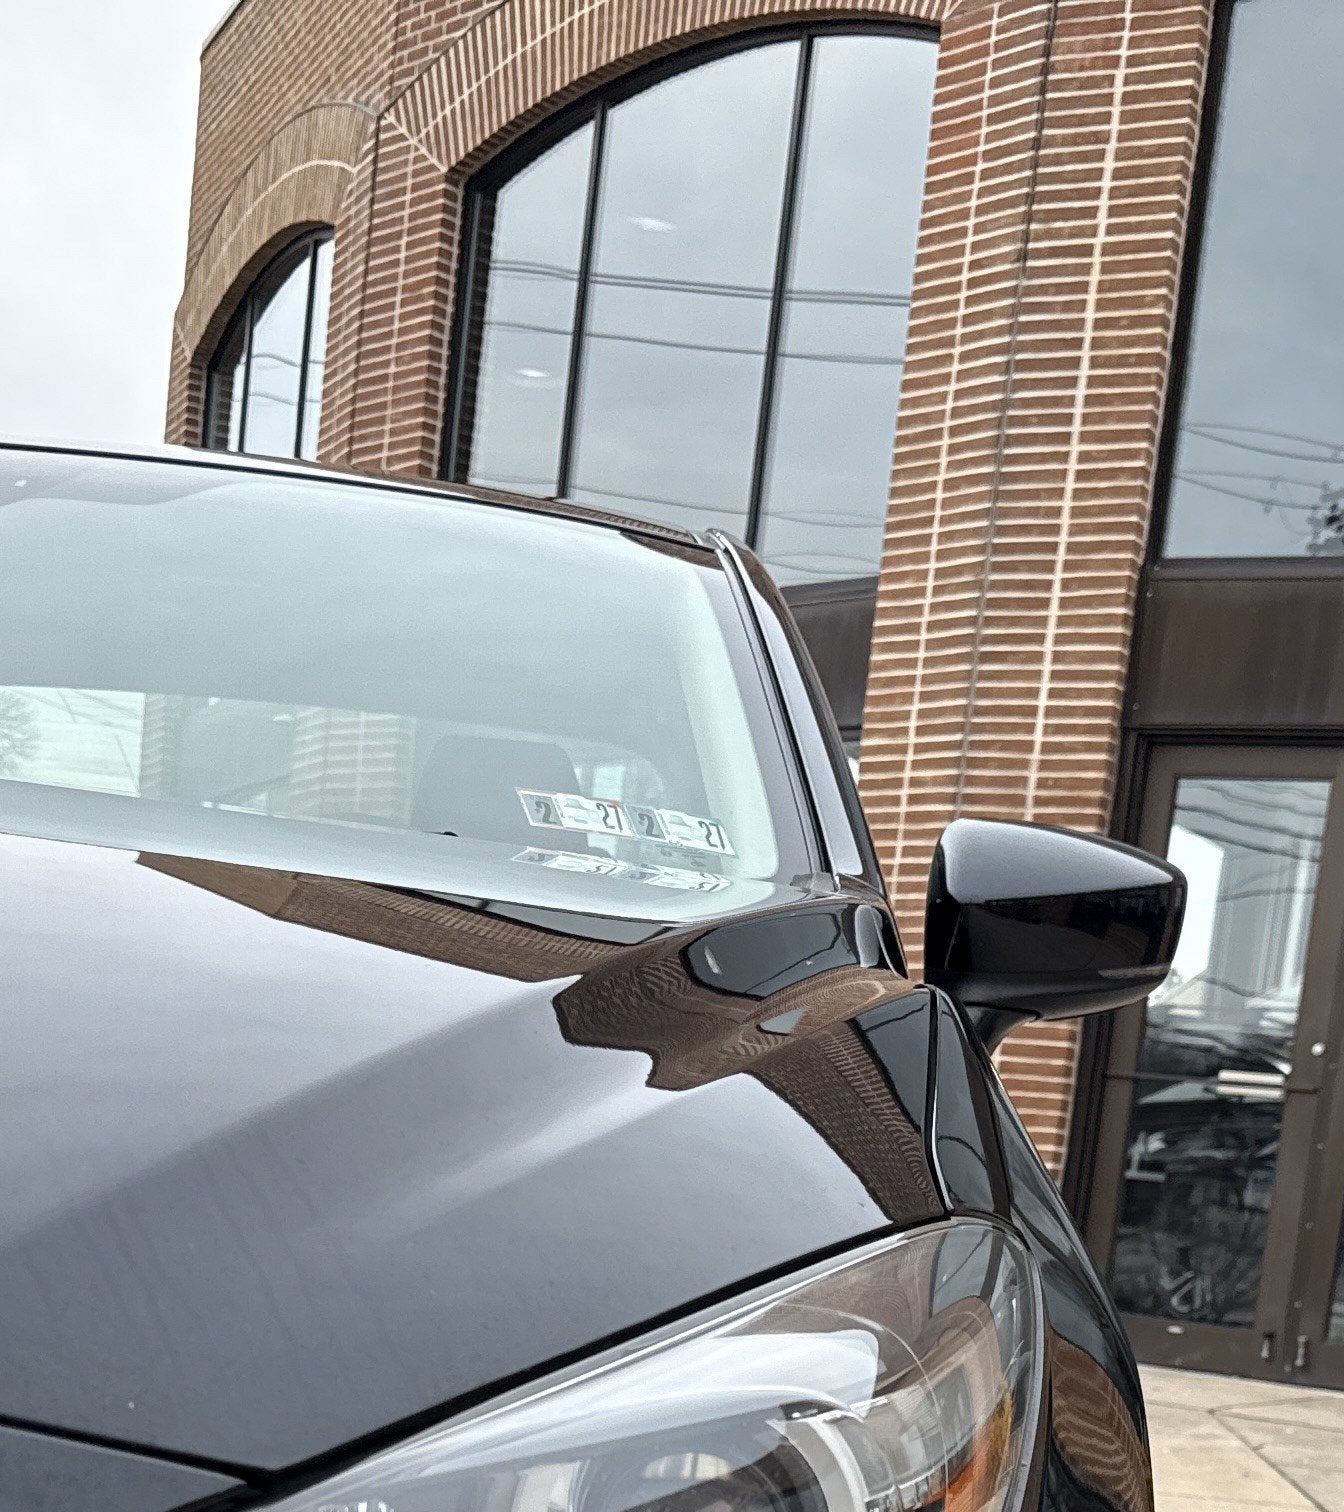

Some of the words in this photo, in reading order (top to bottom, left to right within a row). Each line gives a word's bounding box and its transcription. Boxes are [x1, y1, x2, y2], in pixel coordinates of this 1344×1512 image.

[535, 800, 558, 825] 2
[596, 802, 623, 832] 27
[698, 820, 725, 850] 27
